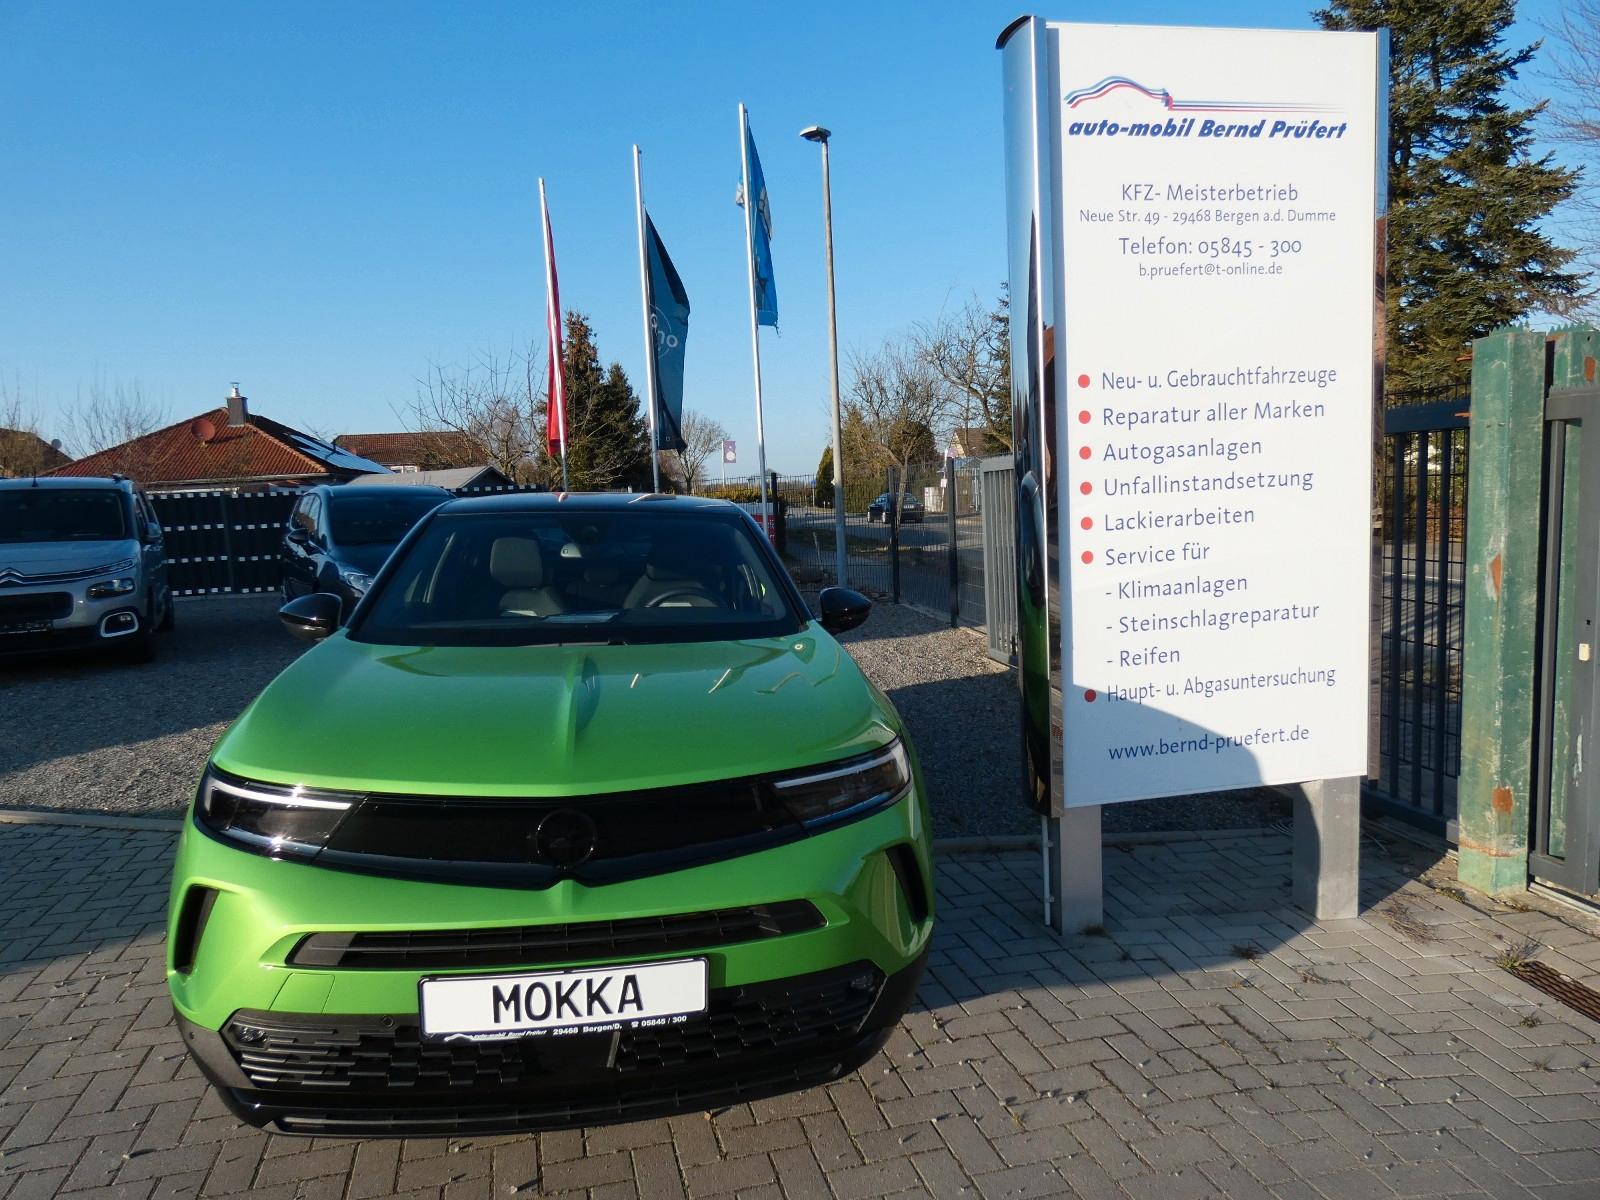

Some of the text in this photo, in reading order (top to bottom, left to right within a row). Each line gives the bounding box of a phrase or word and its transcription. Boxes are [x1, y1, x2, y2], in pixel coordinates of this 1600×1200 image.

[1069, 118, 1347, 139] auto-mobil Bernd Prüfert
[1122, 184, 1298, 201] KFZ- Meisterbetrieb
[1080, 209, 1114, 222] Neue
[1119, 210, 1140, 222] Str.
[1144, 209, 1160, 225] 49
[1172, 208, 1210, 225] 29468
[1216, 210, 1259, 225] Bergen
[1264, 209, 1283, 221] a.d.
[1288, 209, 1335, 221] Dumme
[1118, 236, 1192, 255] Telefon:
[1198, 237, 1252, 258] 05845
[1270, 240, 1301, 257] 300
[1140, 262, 1282, 280] b.pruefert@t-online.de
[1103, 366, 1336, 390] Neu- u. Gebrauchtfahrzeuge
[1104, 400, 1324, 430] Reparatur aller Marken
[1103, 438, 1261, 464] Autogasanlagen
[1105, 471, 1313, 496] Unfallinstandsetzung
[1105, 507, 1254, 531] Lackierarbeiten
[1106, 542, 1210, 566] Service für
[1119, 576, 1247, 599] Klimaanlagen
[1120, 604, 1319, 633] Steinschlagreparatur
[1120, 646, 1179, 667] Reifen
[1108, 667, 1336, 704] Haupt- u. Abgasuntersuchung
[1109, 724, 1309, 759] www.bernd-pruefert.de
[492, 974, 644, 1024] MOKKA
[552, 1027, 579, 1036] 29468
[641, 1018, 666, 1027] 05845
[673, 1015, 687, 1023] 300
